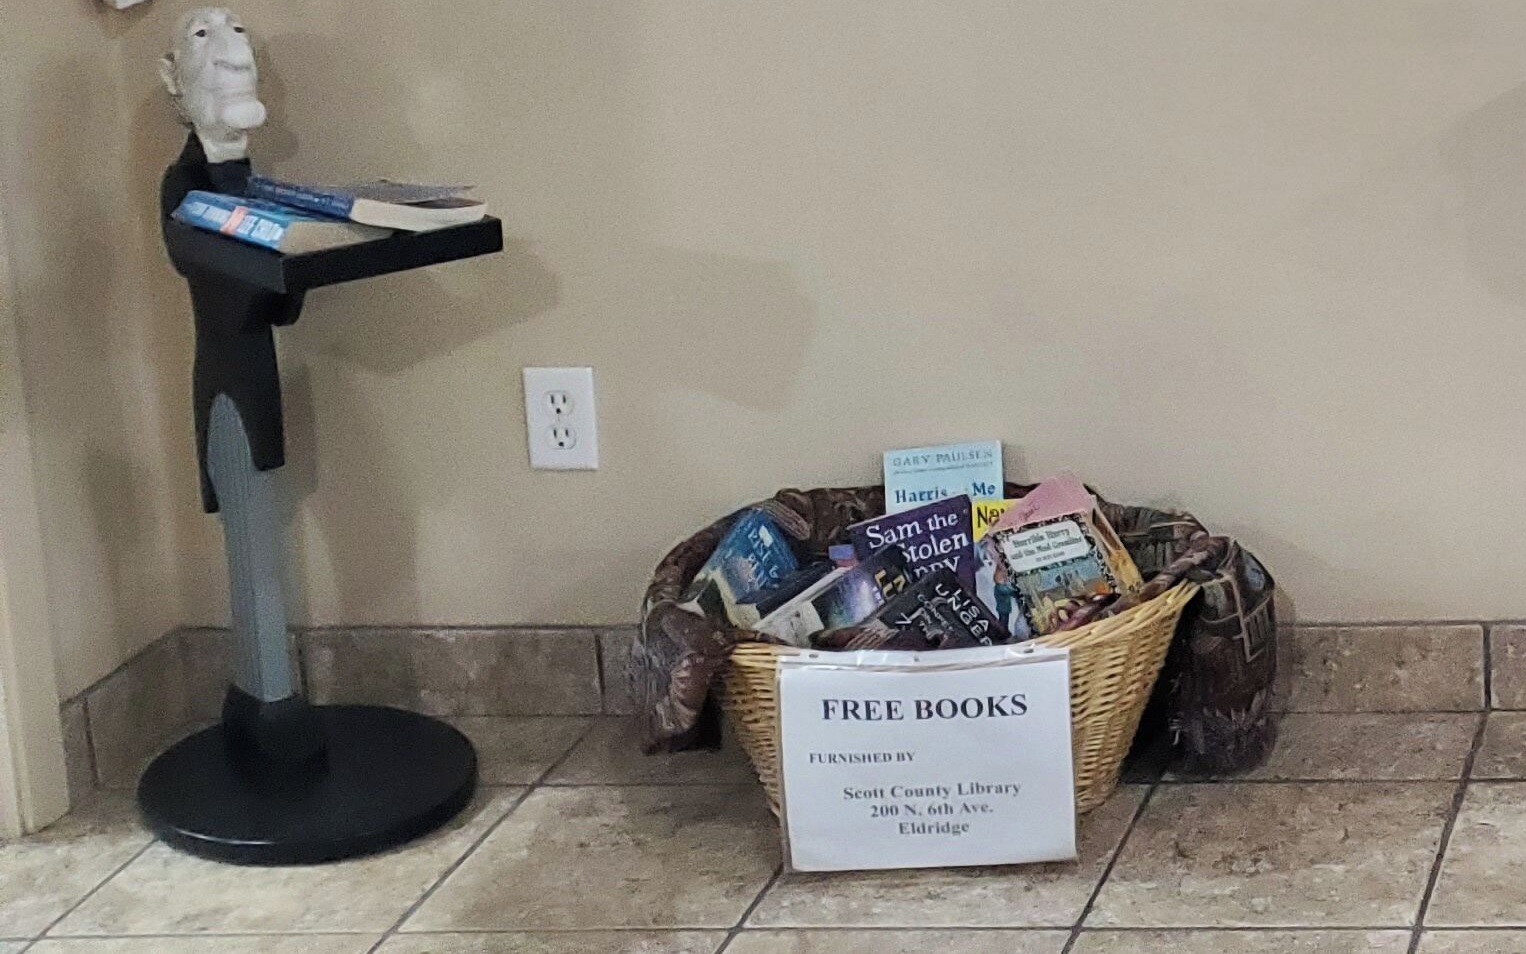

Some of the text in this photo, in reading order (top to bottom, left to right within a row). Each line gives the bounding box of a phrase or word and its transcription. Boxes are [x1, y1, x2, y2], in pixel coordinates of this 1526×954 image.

[893, 449, 994, 467] GARY PAULSEN
[895, 481, 996, 503] Harris Me
[866, 513, 958, 548] Sam the
[951, 589, 989, 632] LISA
[822, 693, 1028, 721] FREE BOOKS
[809, 751, 916, 764] FURNISHED BY
[843, 781, 1021, 800] Scott County Library
[870, 801, 994, 818] 200 N. 6th Ave.
[898, 821, 970, 836] Eldridge
